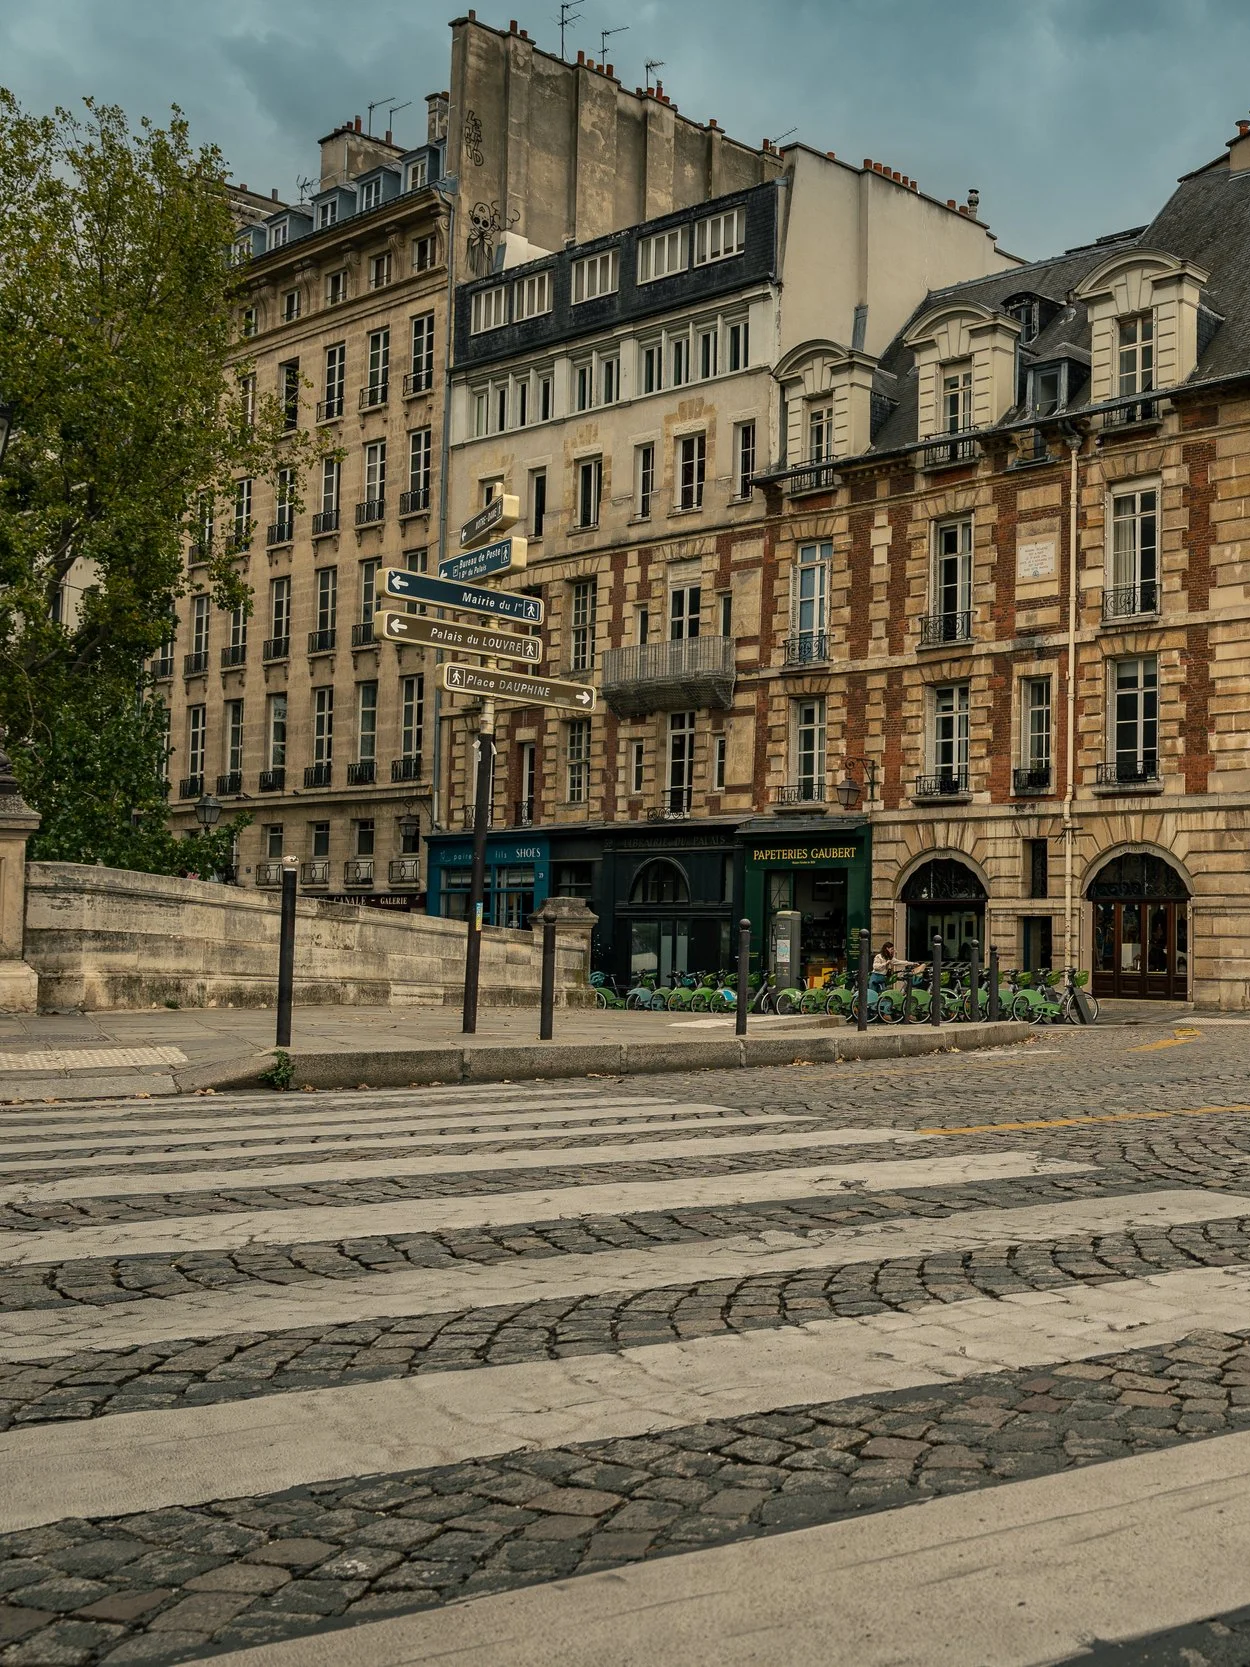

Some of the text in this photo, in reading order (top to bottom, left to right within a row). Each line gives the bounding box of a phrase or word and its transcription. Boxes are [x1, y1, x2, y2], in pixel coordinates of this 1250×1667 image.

[459, 548, 501, 569] Bureau de Poste
[462, 592, 495, 608] Mairie
[499, 600, 511, 611] du
[430, 627, 522, 652] Palais du LOUVRE
[466, 674, 551, 697] Place DAUPHINE
[515, 848, 541, 858] SHOES
[753, 847, 857, 860] PAPETERIES GAUBERT
[380, 897, 408, 905] GALERIE
